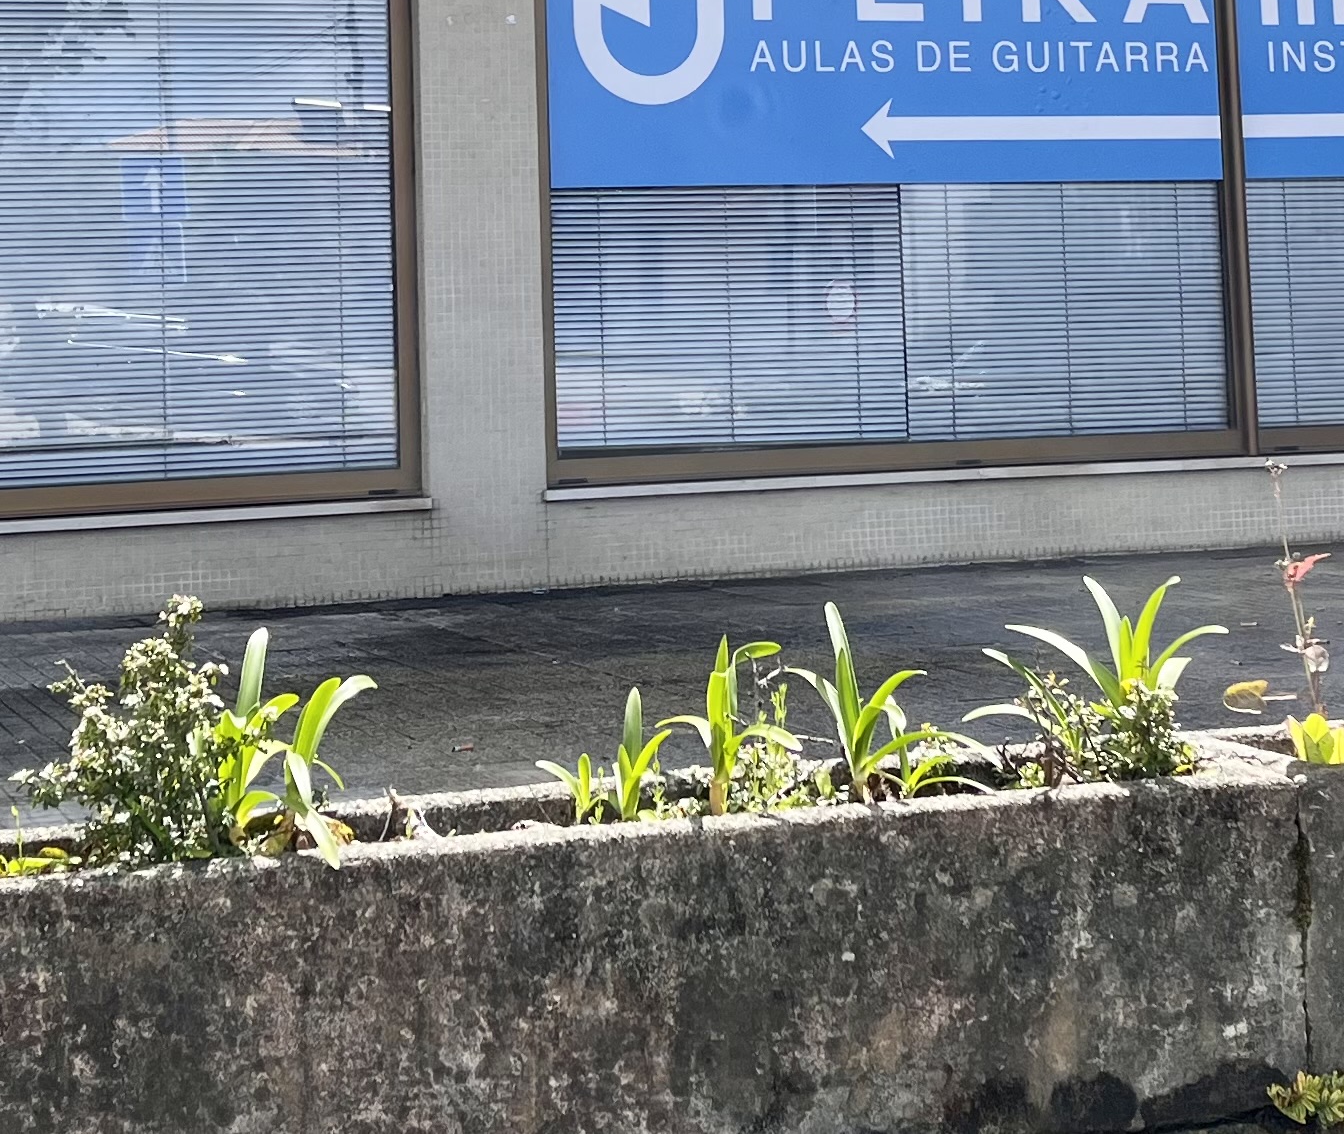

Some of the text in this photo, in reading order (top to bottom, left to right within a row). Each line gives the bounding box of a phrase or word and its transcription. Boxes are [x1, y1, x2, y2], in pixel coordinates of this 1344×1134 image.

[750, 39, 1210, 74] AULAS DE GUITARRA
